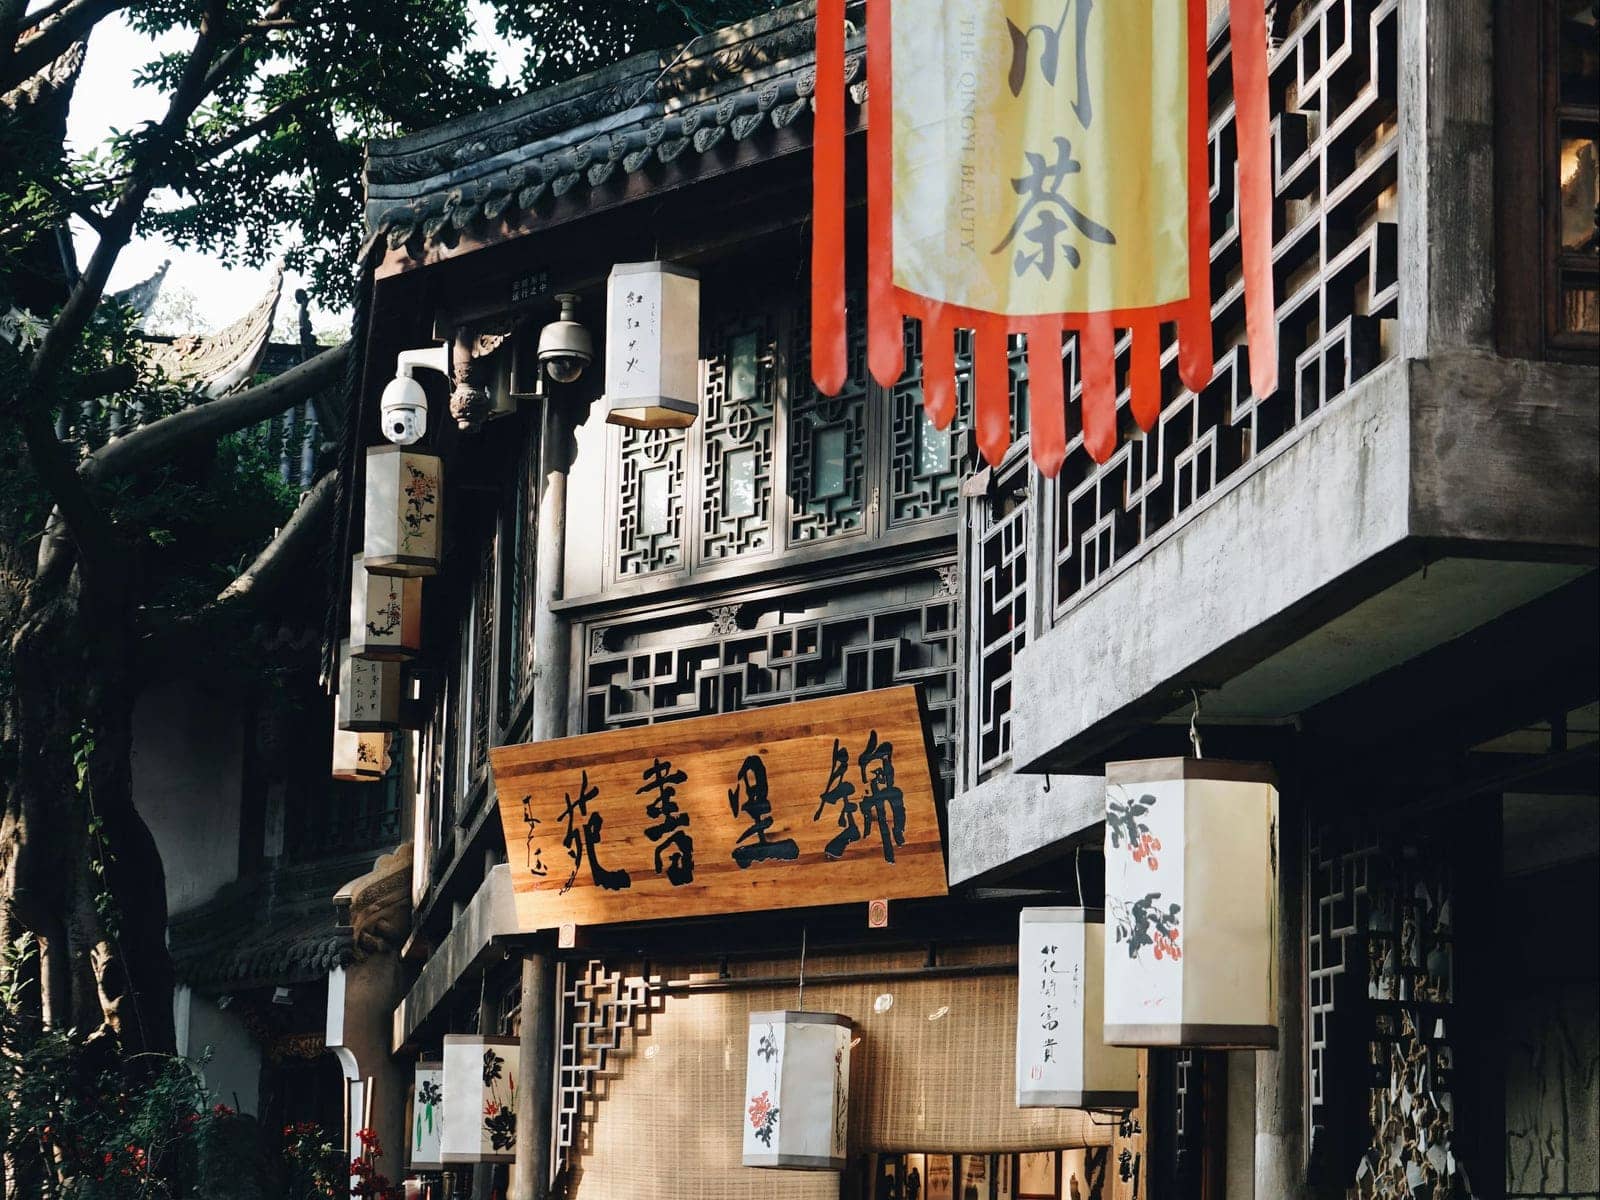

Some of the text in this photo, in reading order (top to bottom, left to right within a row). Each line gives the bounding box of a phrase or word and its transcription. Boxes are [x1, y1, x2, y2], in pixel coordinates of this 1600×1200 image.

[957, 16, 977, 252] THE QINGYI BEAUTY
[990, 0, 1117, 282] 川茶
